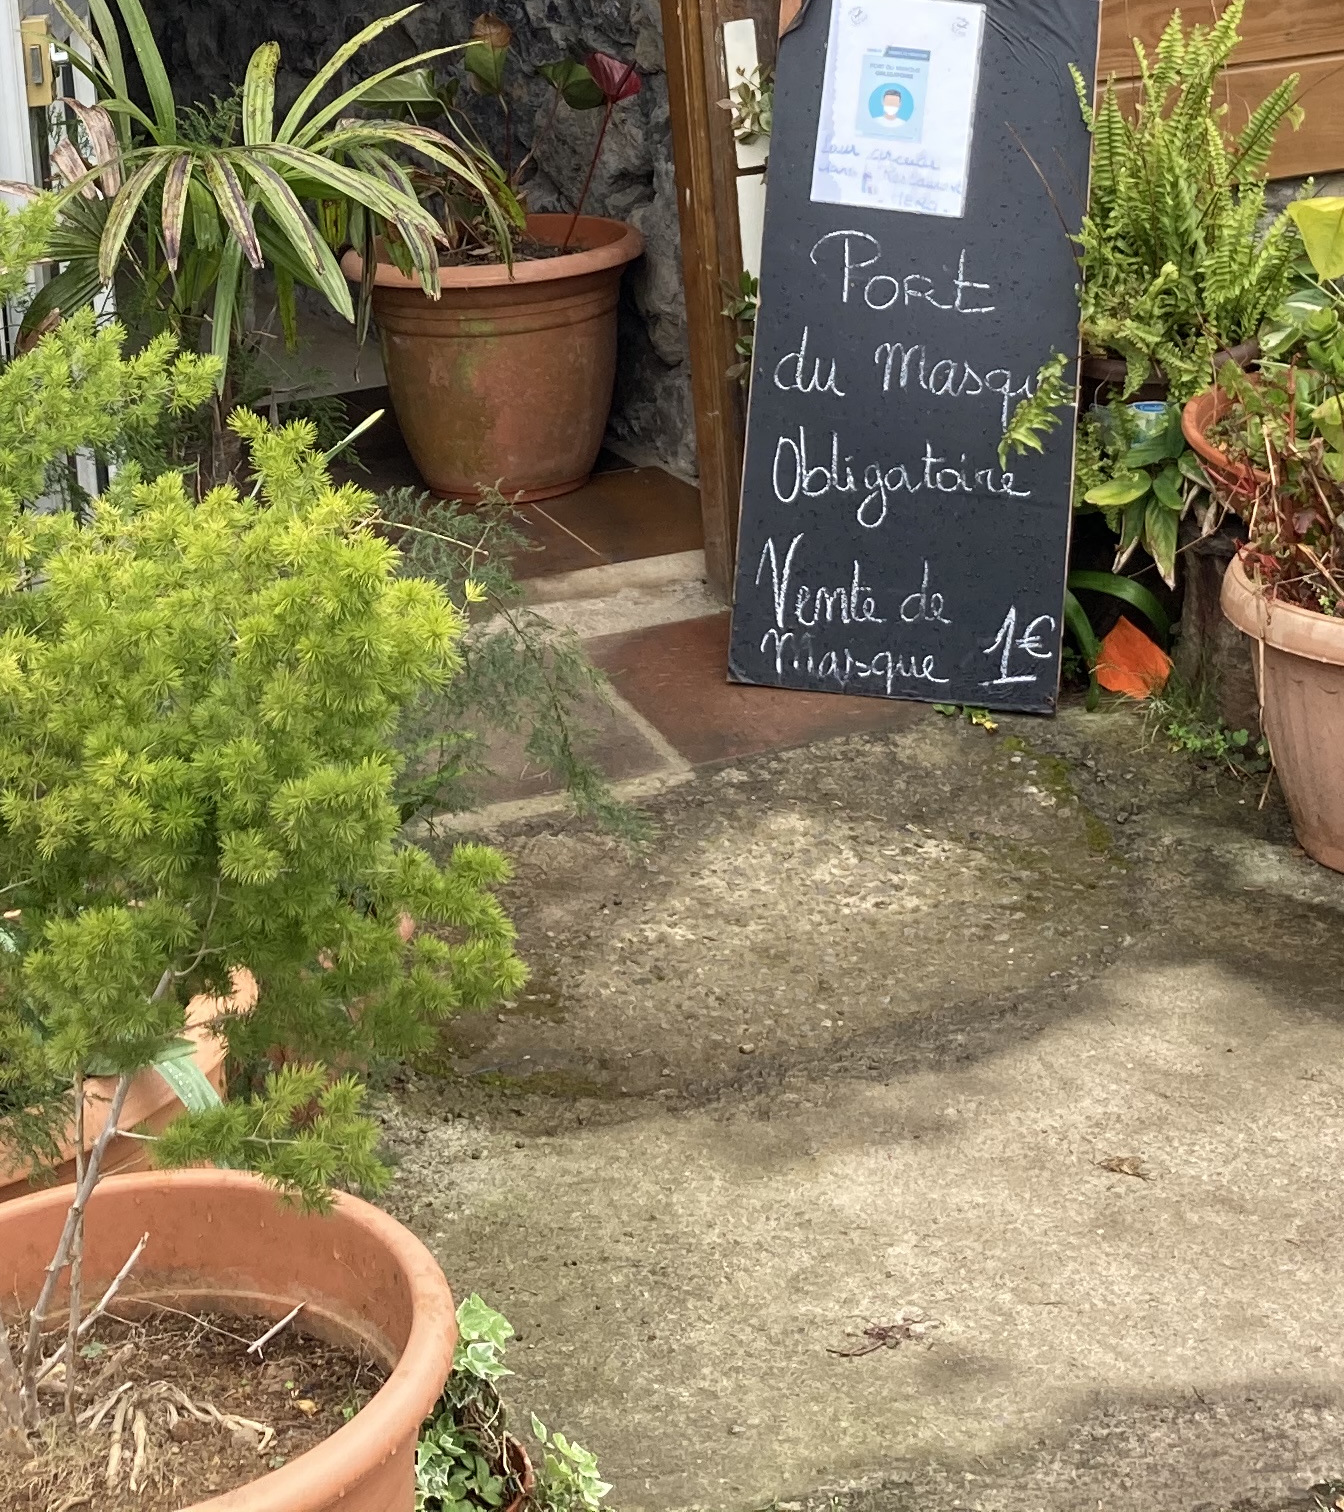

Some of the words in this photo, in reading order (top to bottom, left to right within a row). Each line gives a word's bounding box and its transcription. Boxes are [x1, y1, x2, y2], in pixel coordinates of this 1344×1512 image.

[774, 326, 846, 397] du
[874, 342, 1044, 431] Masq
[773, 425, 1031, 528] Obligatoire
[756, 532, 887, 628] Vente
[899, 556, 953, 625] de
[978, 605, 1056, 686] 1€
